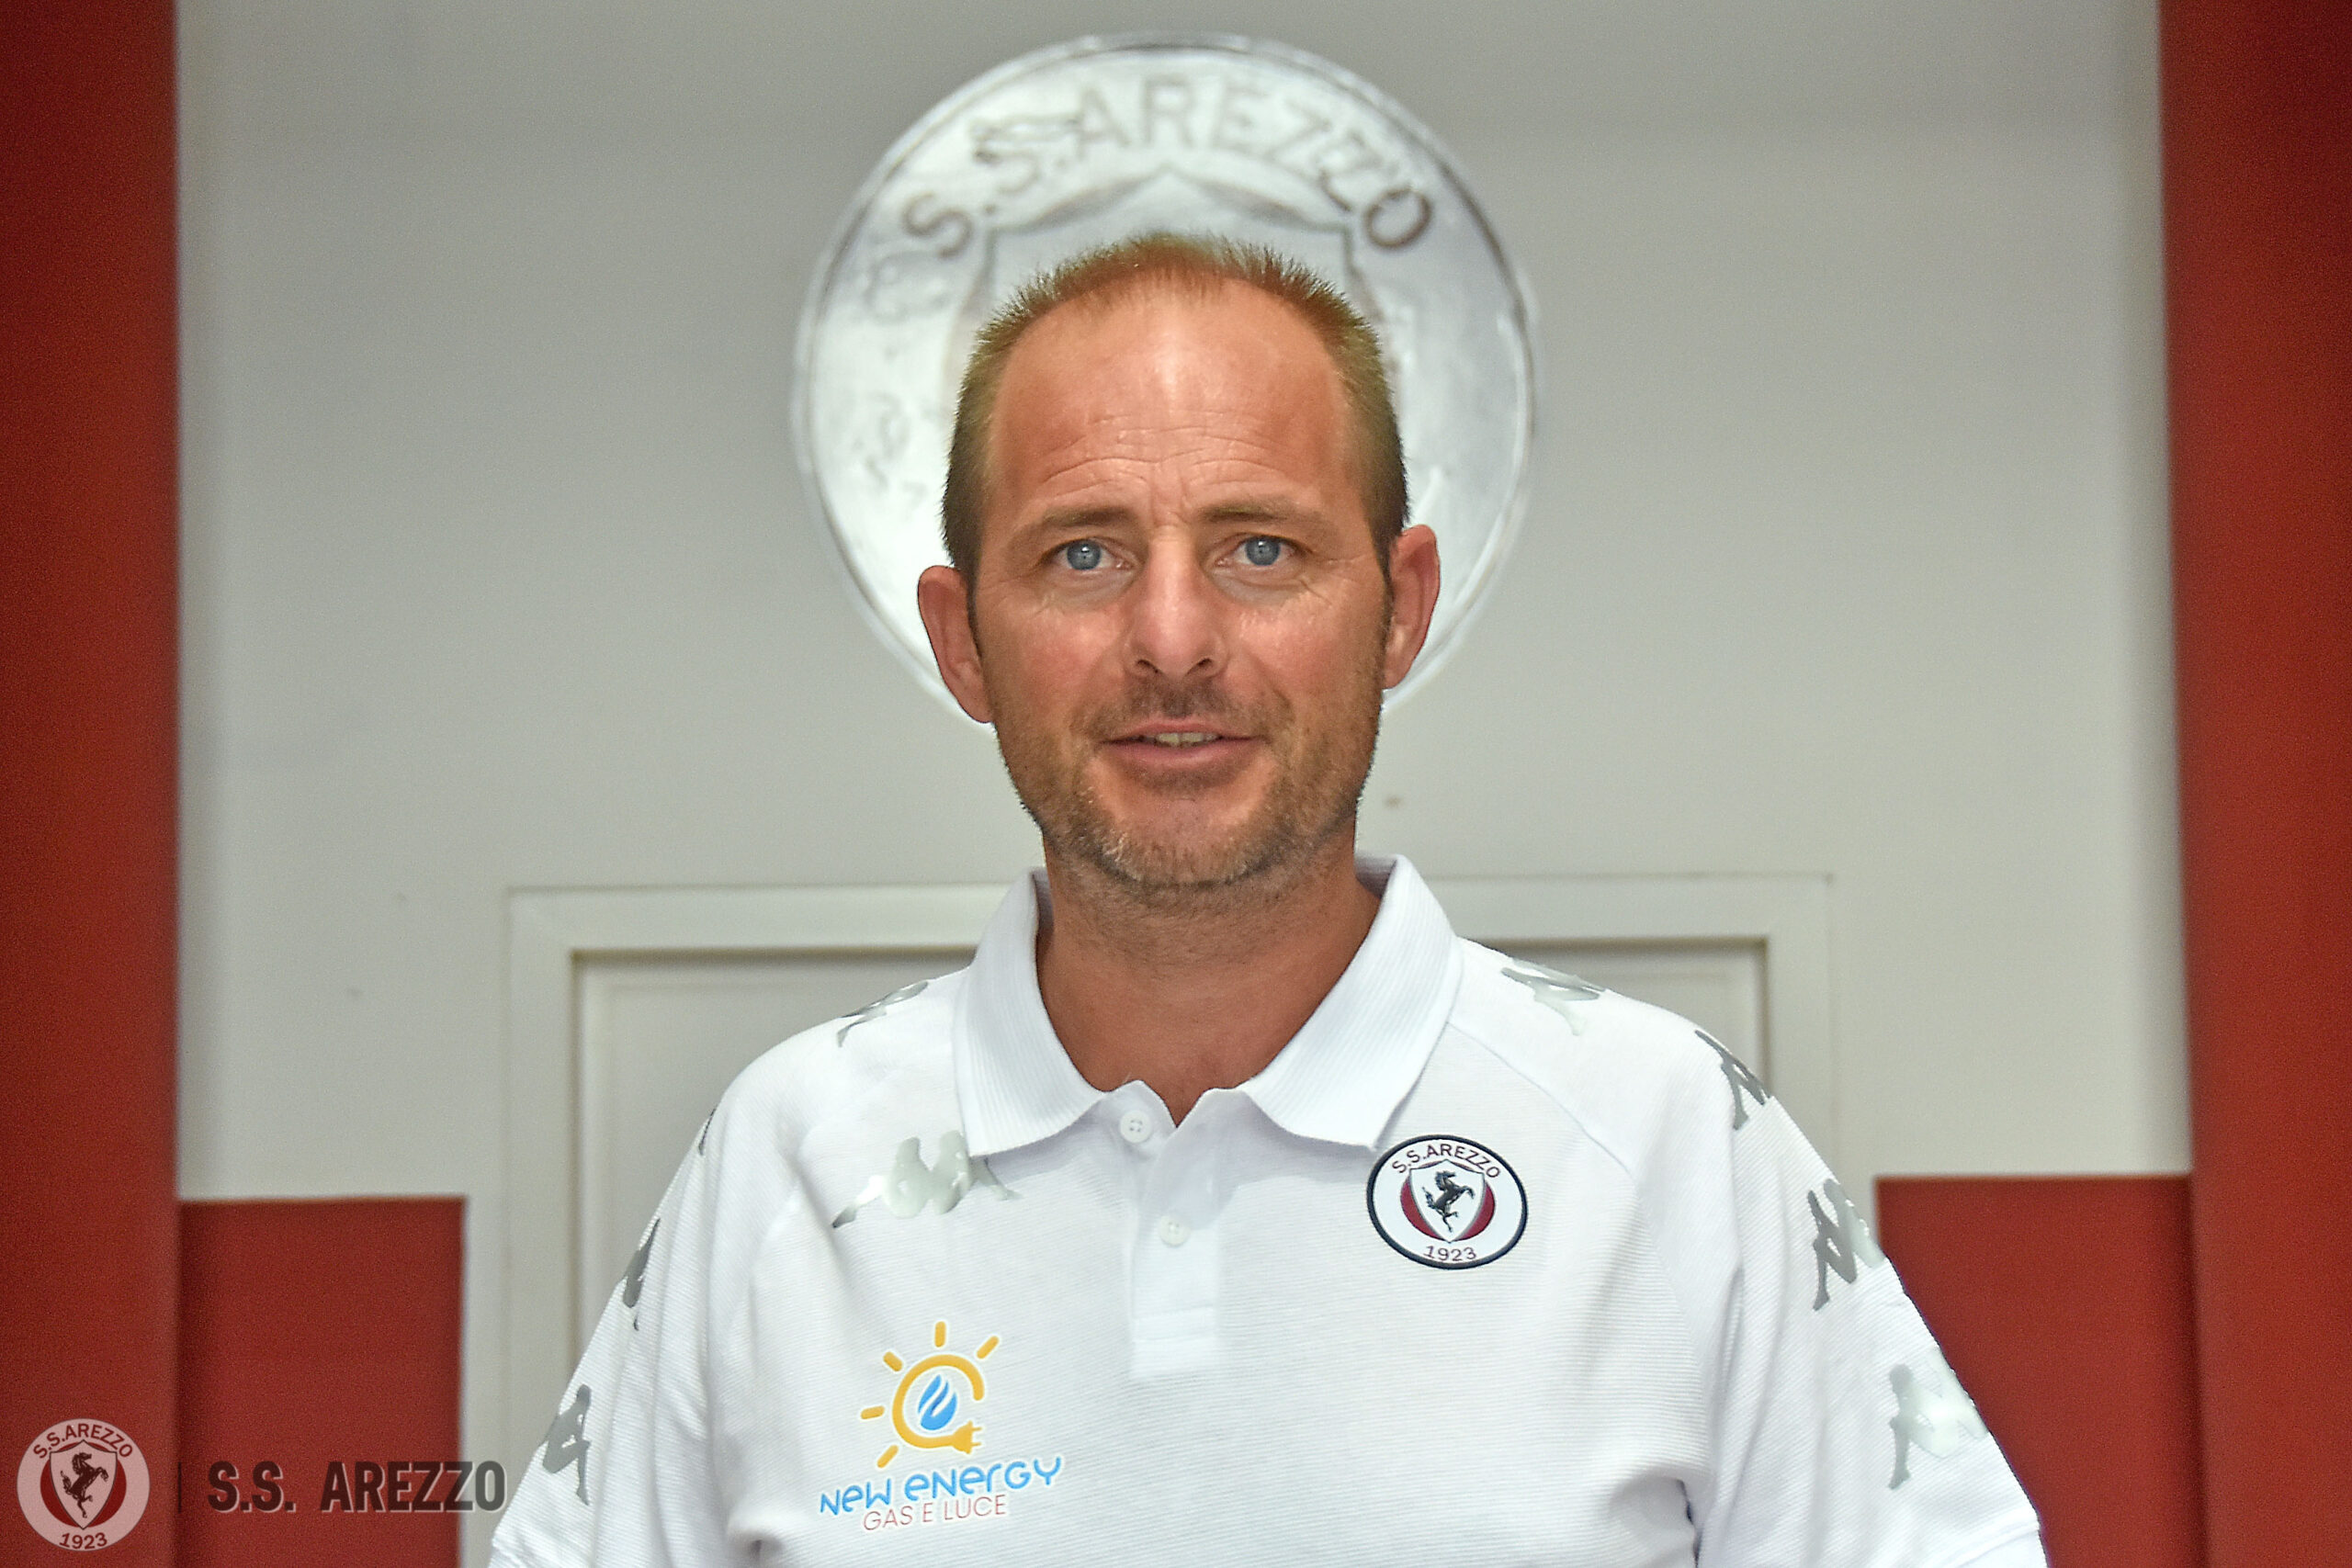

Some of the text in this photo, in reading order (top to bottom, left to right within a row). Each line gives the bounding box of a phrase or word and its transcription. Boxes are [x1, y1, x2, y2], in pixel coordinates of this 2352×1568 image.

[1423, 1246, 1476, 1262] 1923
[863, 1495, 1007, 1530] GAS E LUCE
